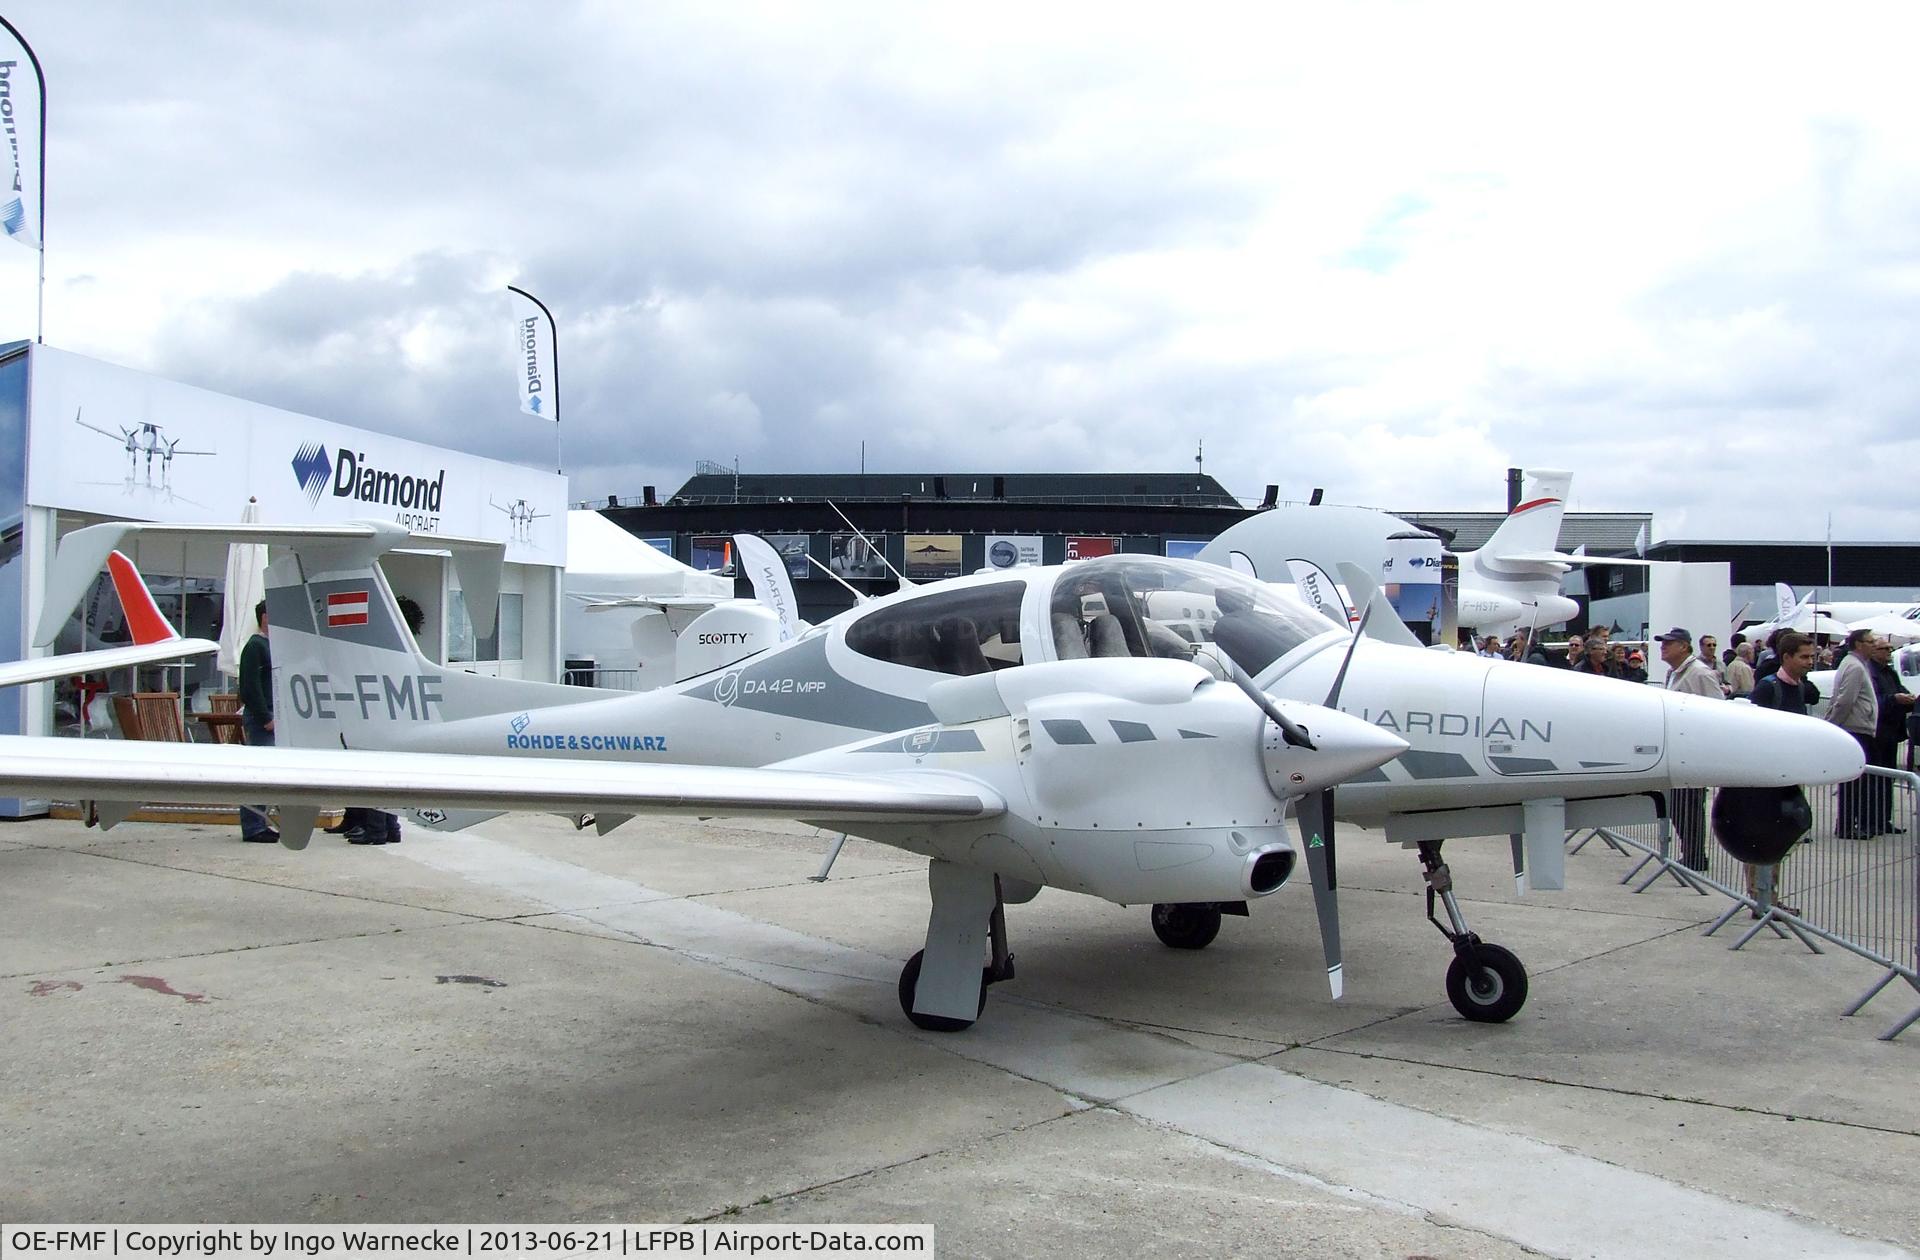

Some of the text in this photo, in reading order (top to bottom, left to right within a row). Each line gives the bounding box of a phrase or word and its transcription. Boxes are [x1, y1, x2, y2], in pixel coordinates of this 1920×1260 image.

[333, 448, 445, 512] Diamond
[699, 633, 748, 645] SCOTTY
[743, 679, 826, 694] DA42 MPP
[290, 673, 443, 721] OE-FMF
[507, 734, 667, 751] ROHDE&SCHWARZ
